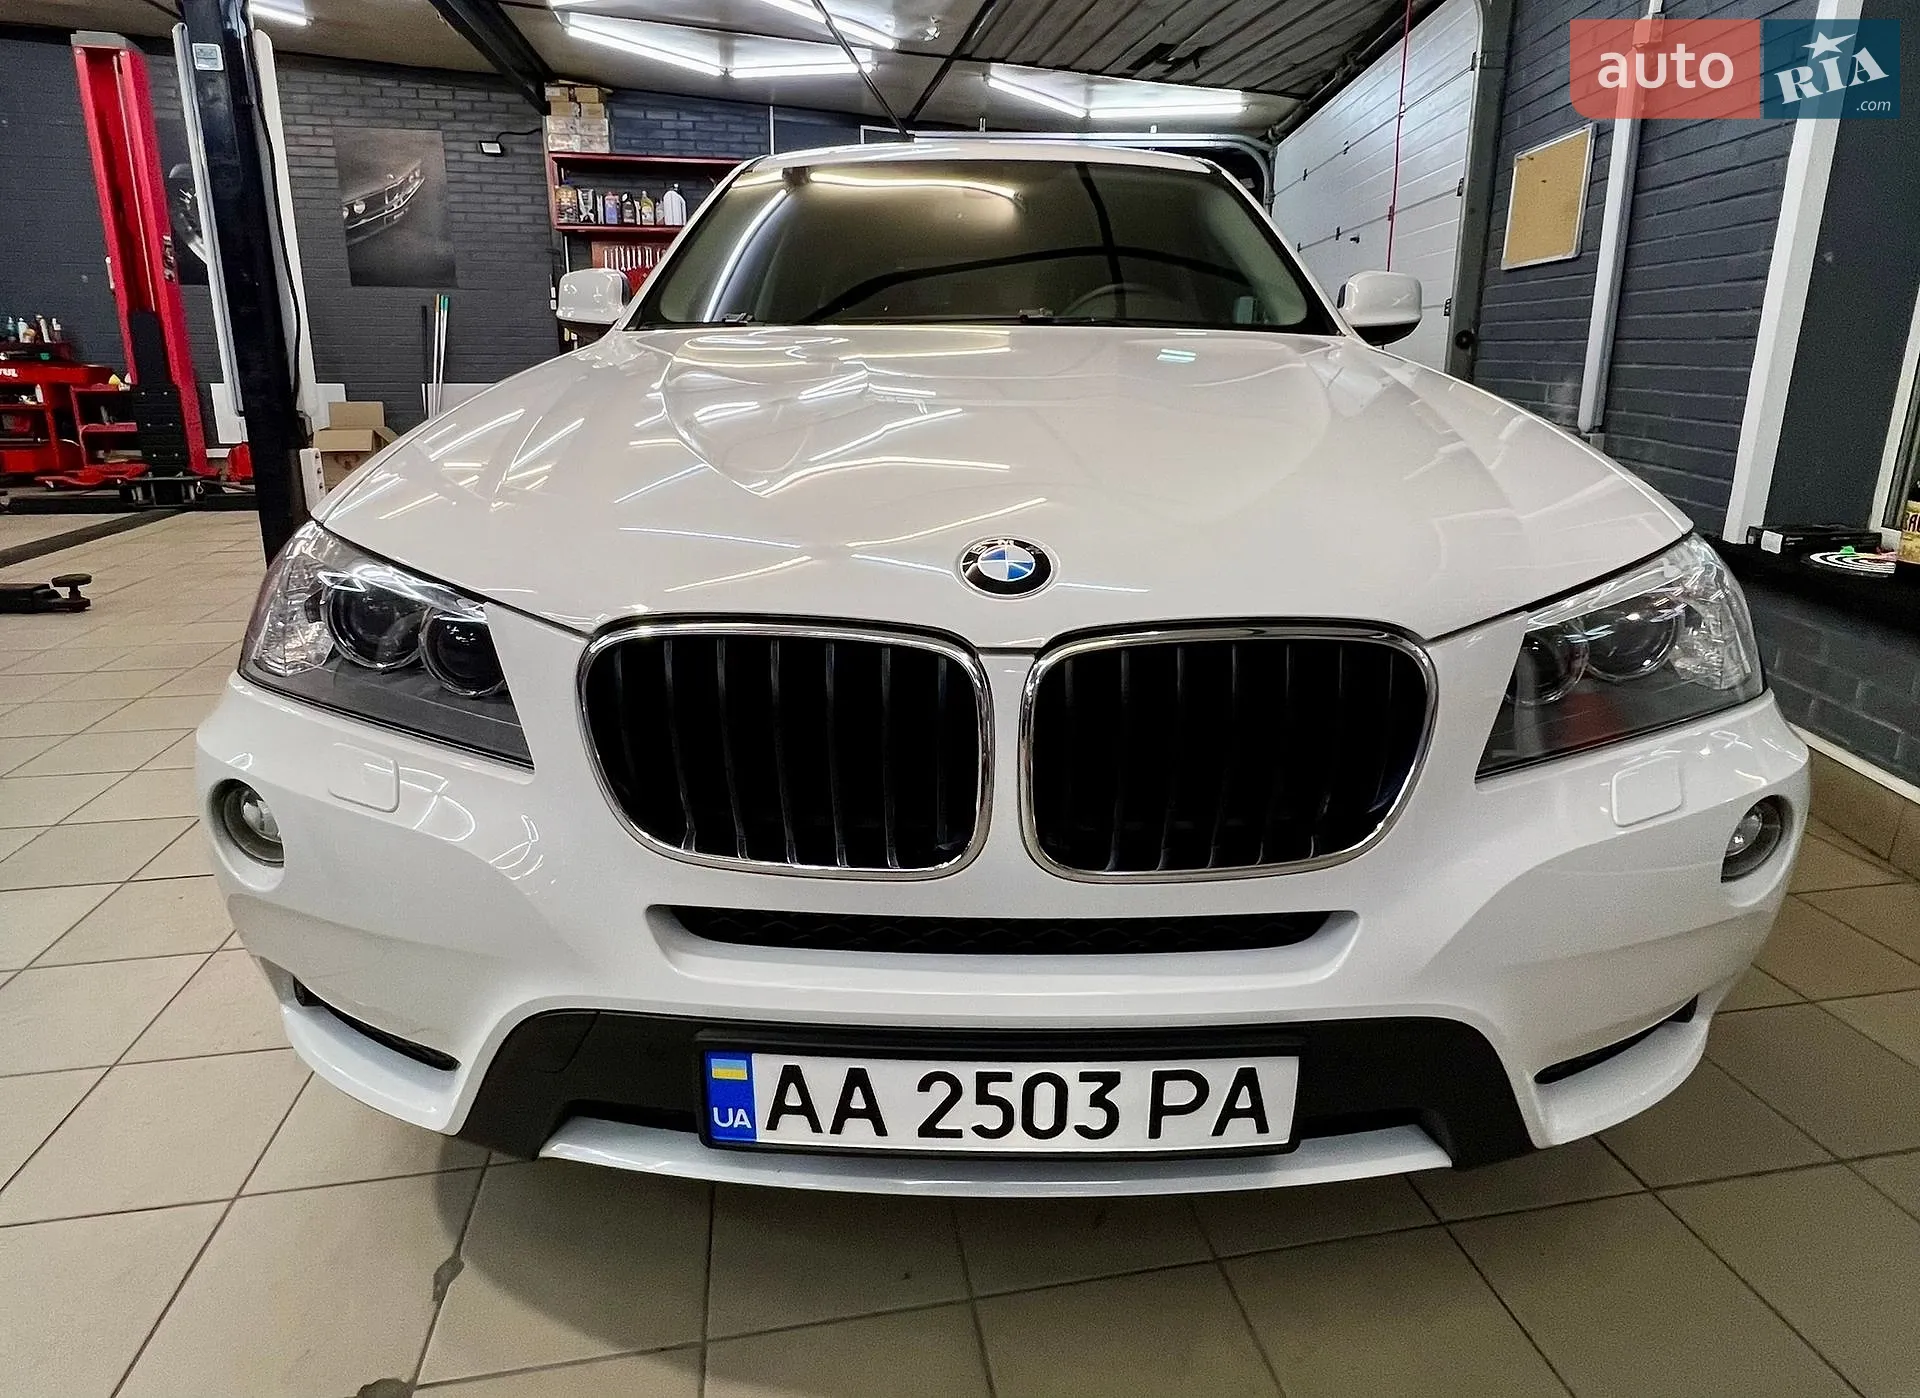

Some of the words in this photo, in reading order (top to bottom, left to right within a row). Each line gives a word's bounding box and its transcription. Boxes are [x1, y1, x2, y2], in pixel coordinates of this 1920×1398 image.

[712, 1106, 752, 1130] UA
[766, 1064, 888, 1137] AA
[916, 1070, 1121, 1140] 2503
[1148, 1067, 1270, 1139] PA
